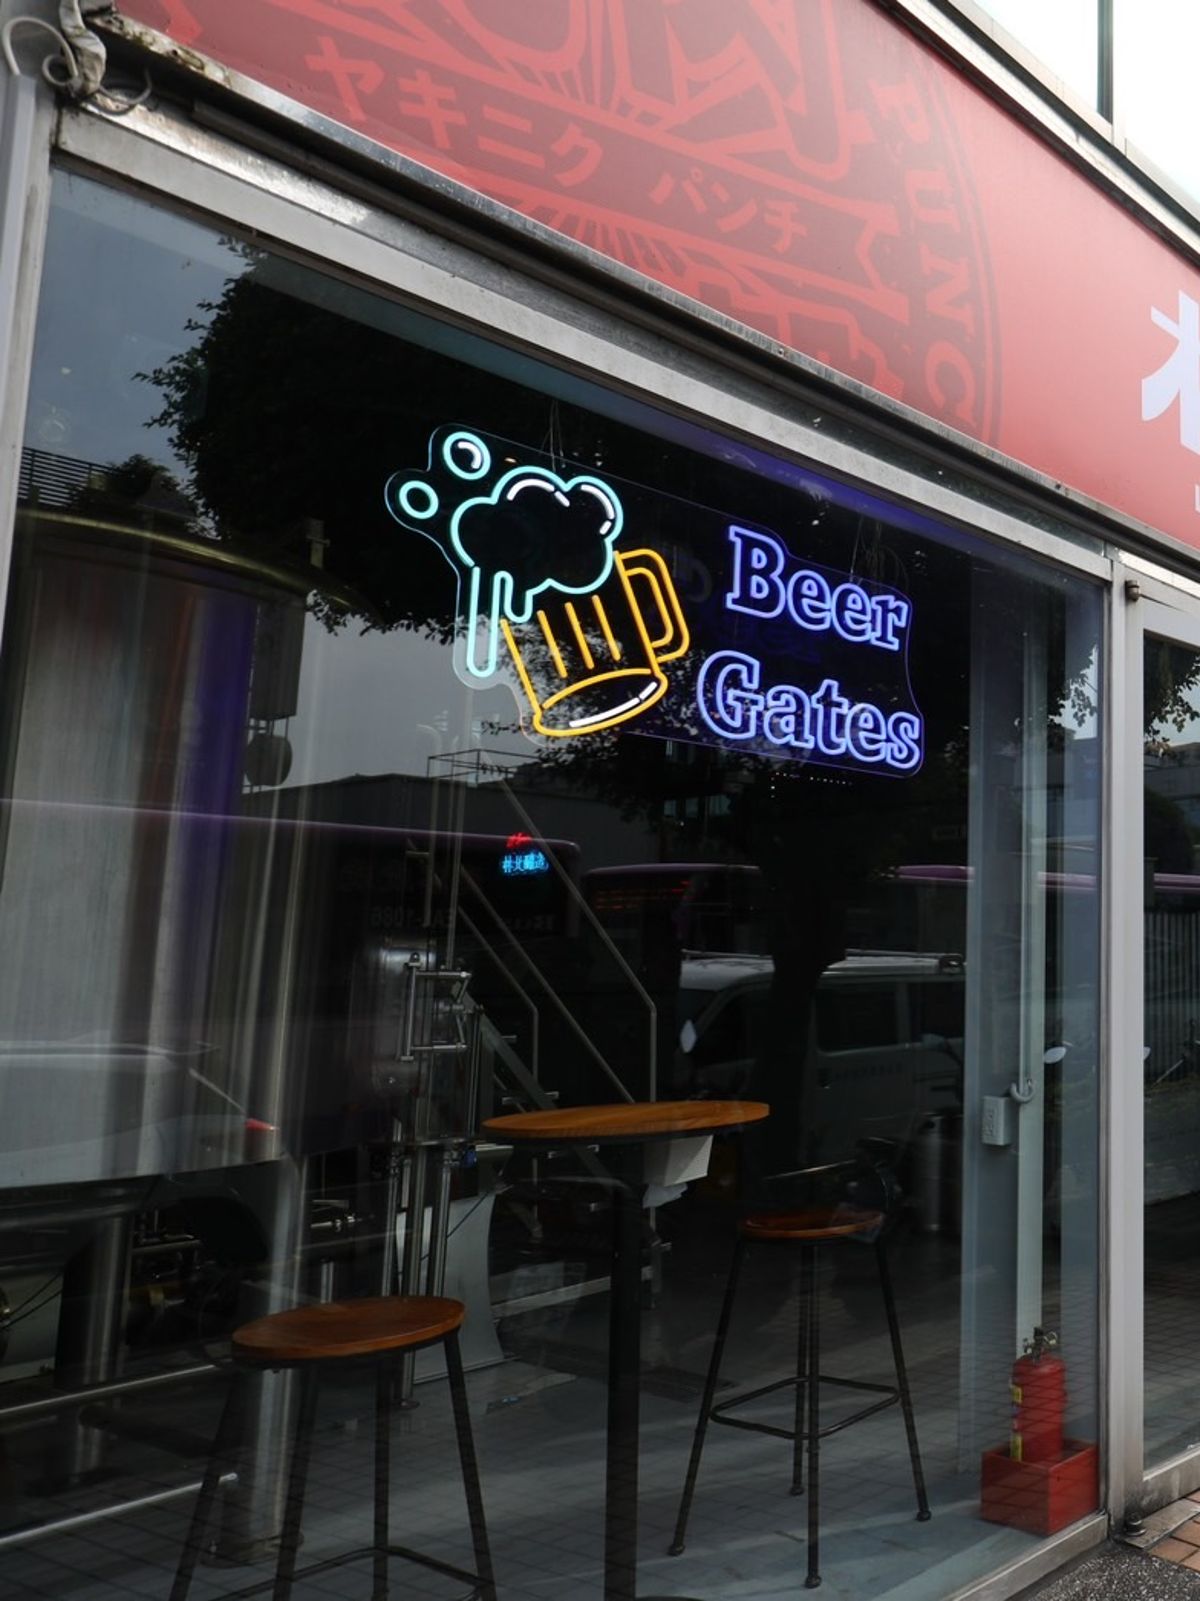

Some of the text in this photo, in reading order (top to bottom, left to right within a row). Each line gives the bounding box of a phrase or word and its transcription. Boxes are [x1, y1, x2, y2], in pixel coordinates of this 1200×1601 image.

[304, 35, 808, 252] ヤキニク パンチ
[726, 525, 908, 651] Beer
[696, 649, 923, 771] Gates
